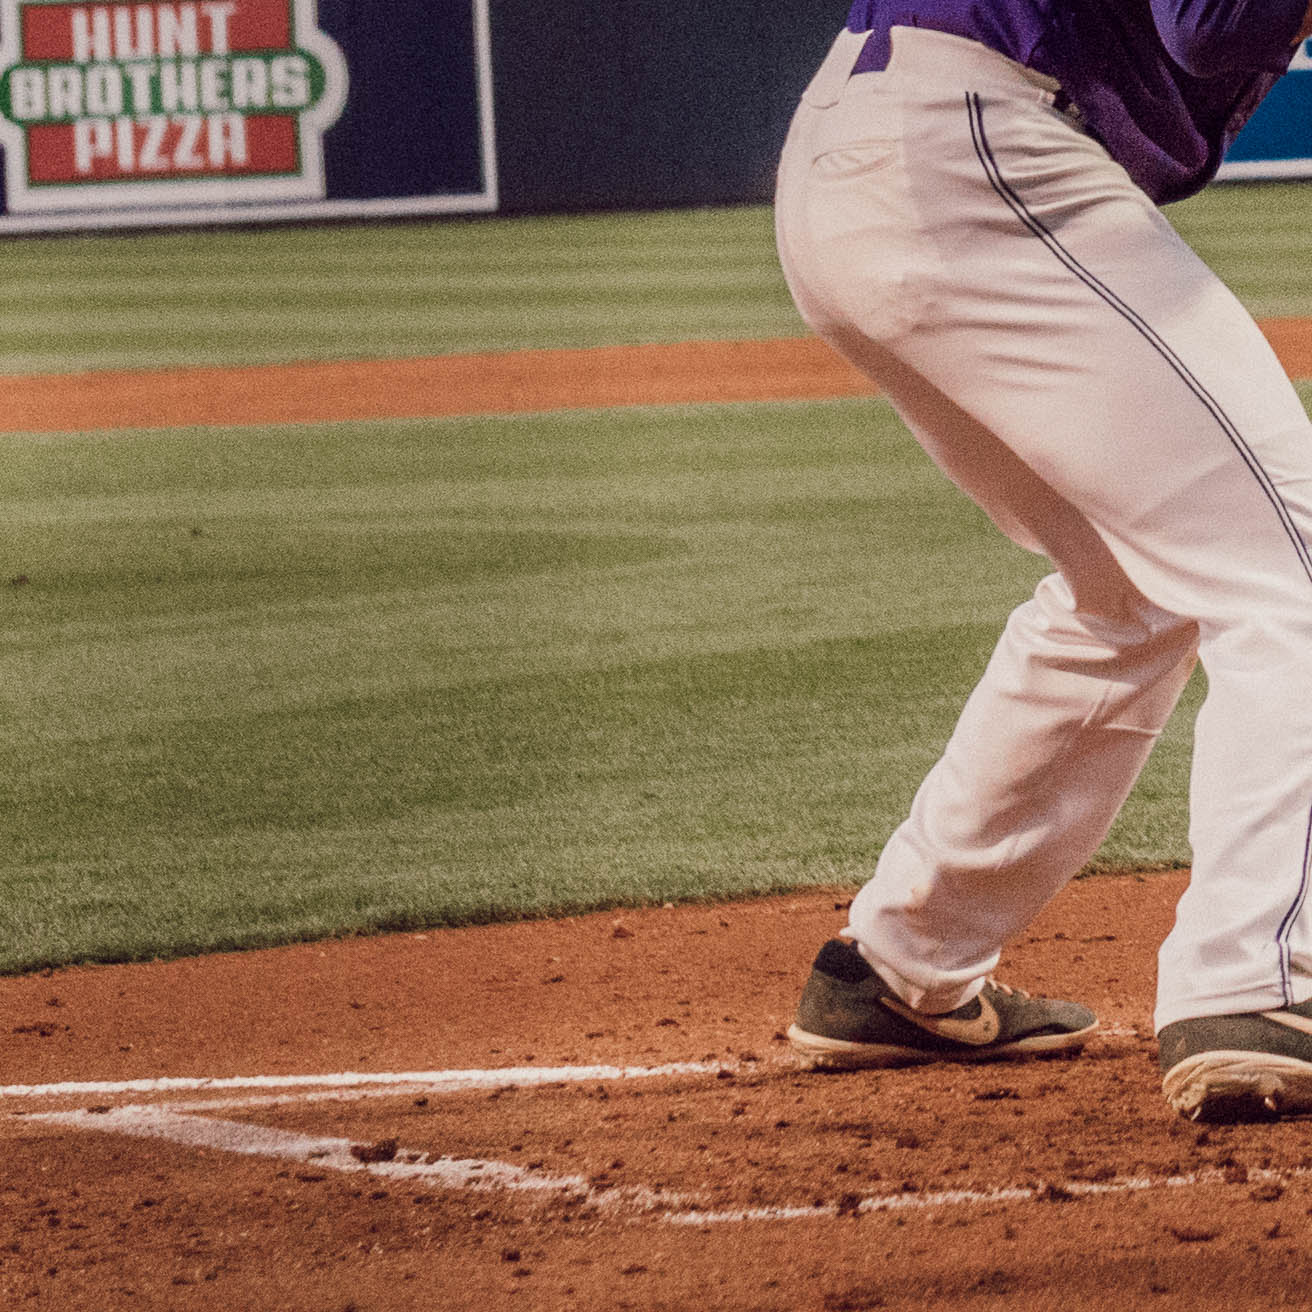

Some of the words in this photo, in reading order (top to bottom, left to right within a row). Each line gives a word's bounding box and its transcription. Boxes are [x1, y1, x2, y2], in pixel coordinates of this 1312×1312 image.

[72, 0, 236, 63] HUNT
[8, 54, 312, 121] BROTHERS
[73, 112, 248, 174] PIZZA
